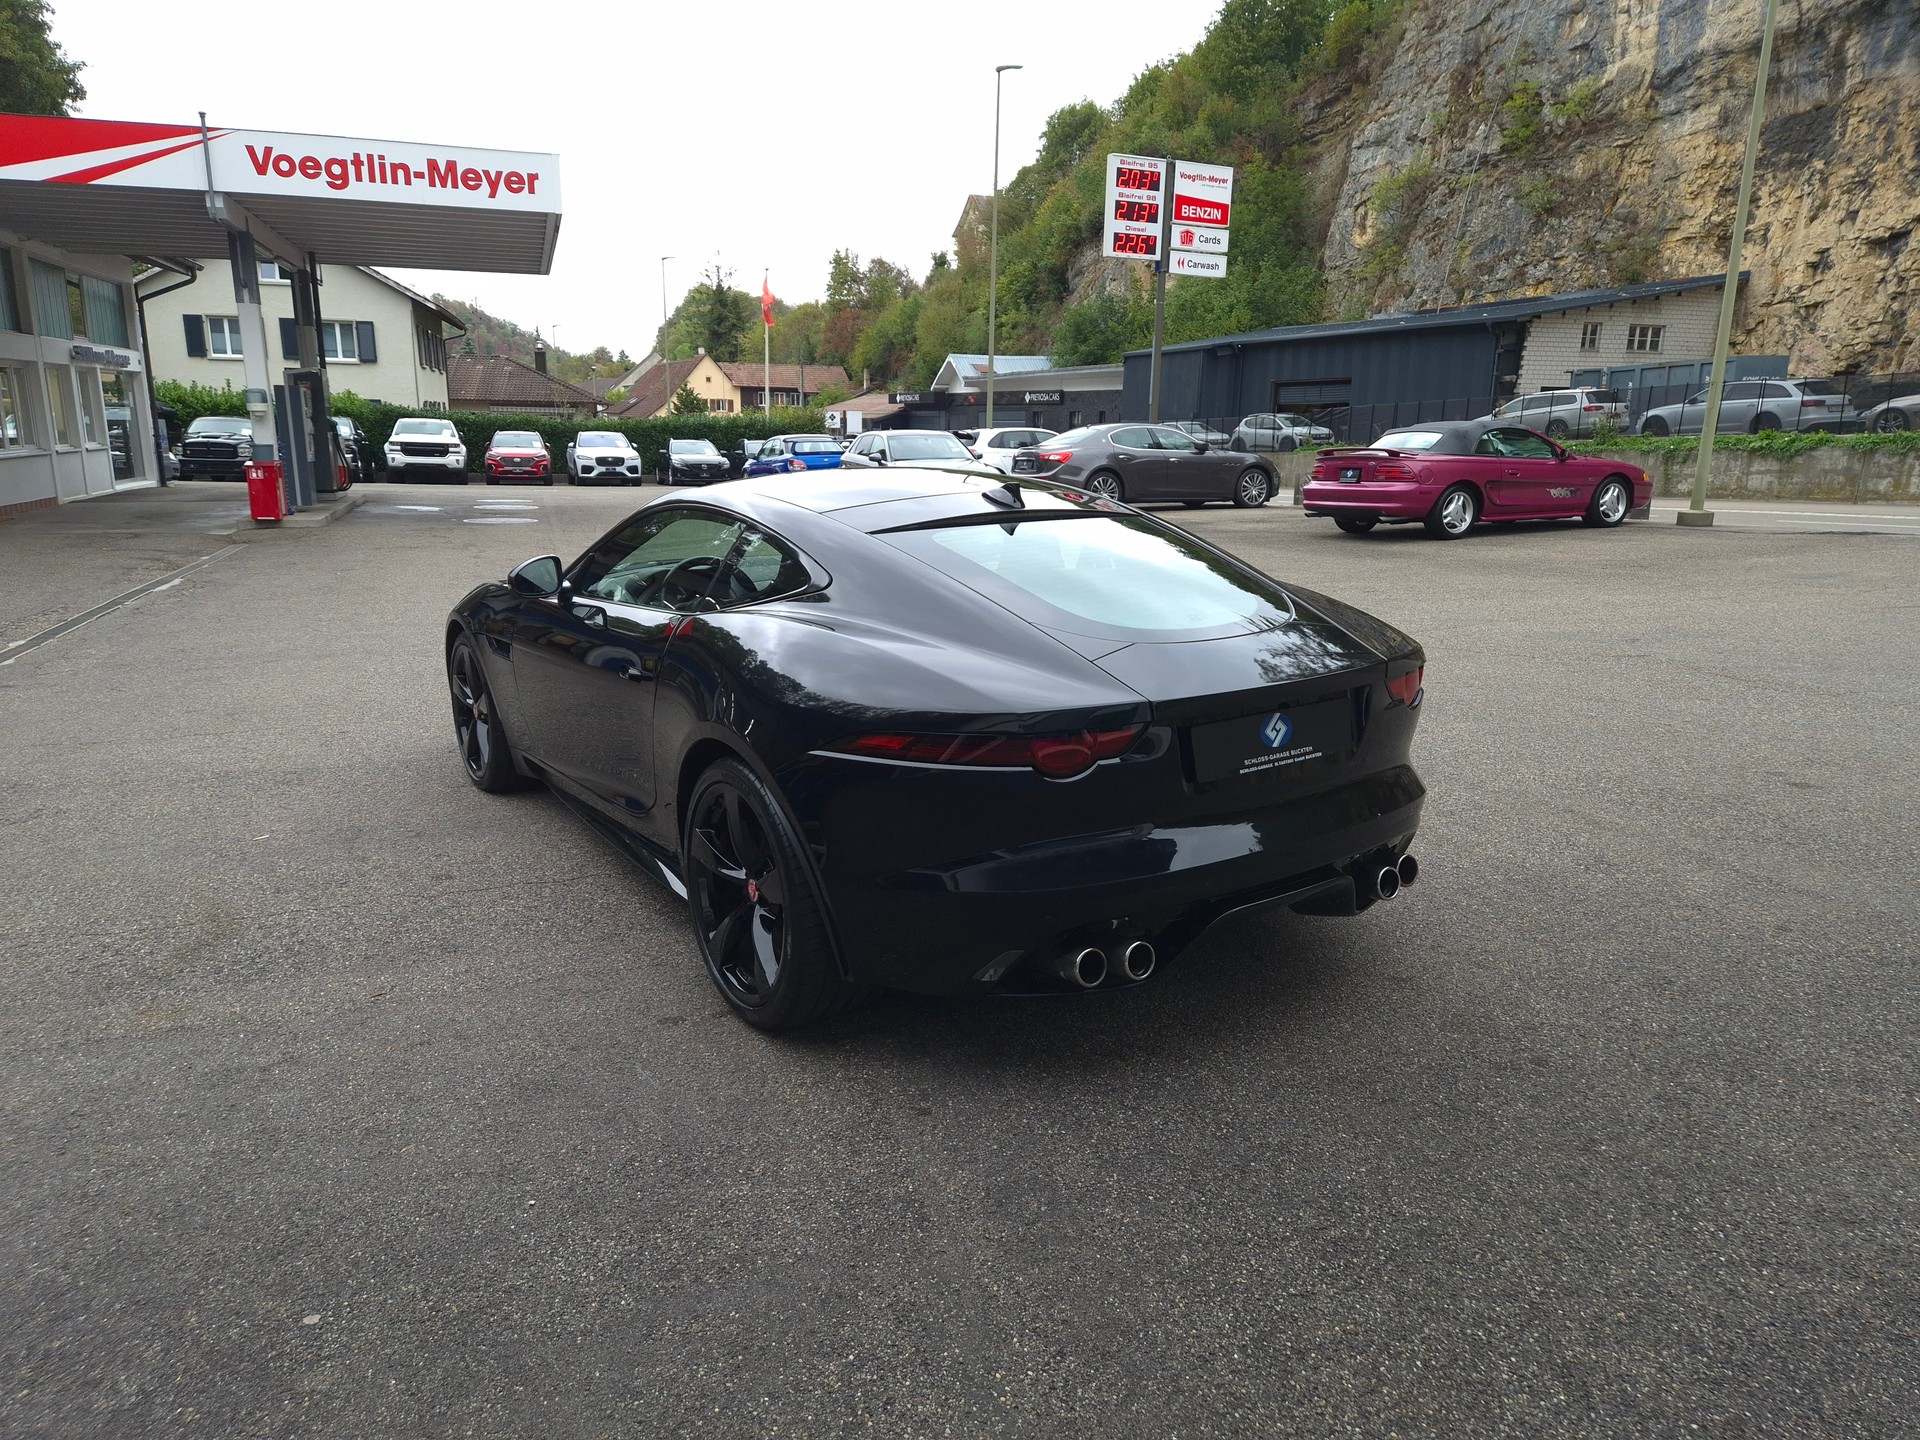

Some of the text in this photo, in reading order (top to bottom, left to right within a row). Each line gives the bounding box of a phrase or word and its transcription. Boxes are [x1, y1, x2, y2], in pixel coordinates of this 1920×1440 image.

[1120, 159, 1146, 168] Bleifrei
[244, 144, 540, 199] Voegtlin-Meyer
[1179, 171, 1229, 184] Voegtlin-Meyer
[1118, 192, 1144, 200] Bleifrei
[1181, 205, 1221, 220] BENZIN
[1198, 234, 1222, 245] Cards
[1187, 259, 1220, 271] Carwash
[1244, 746, 1313, 766] SCHLOSS-GARAGE BUCKTEN
